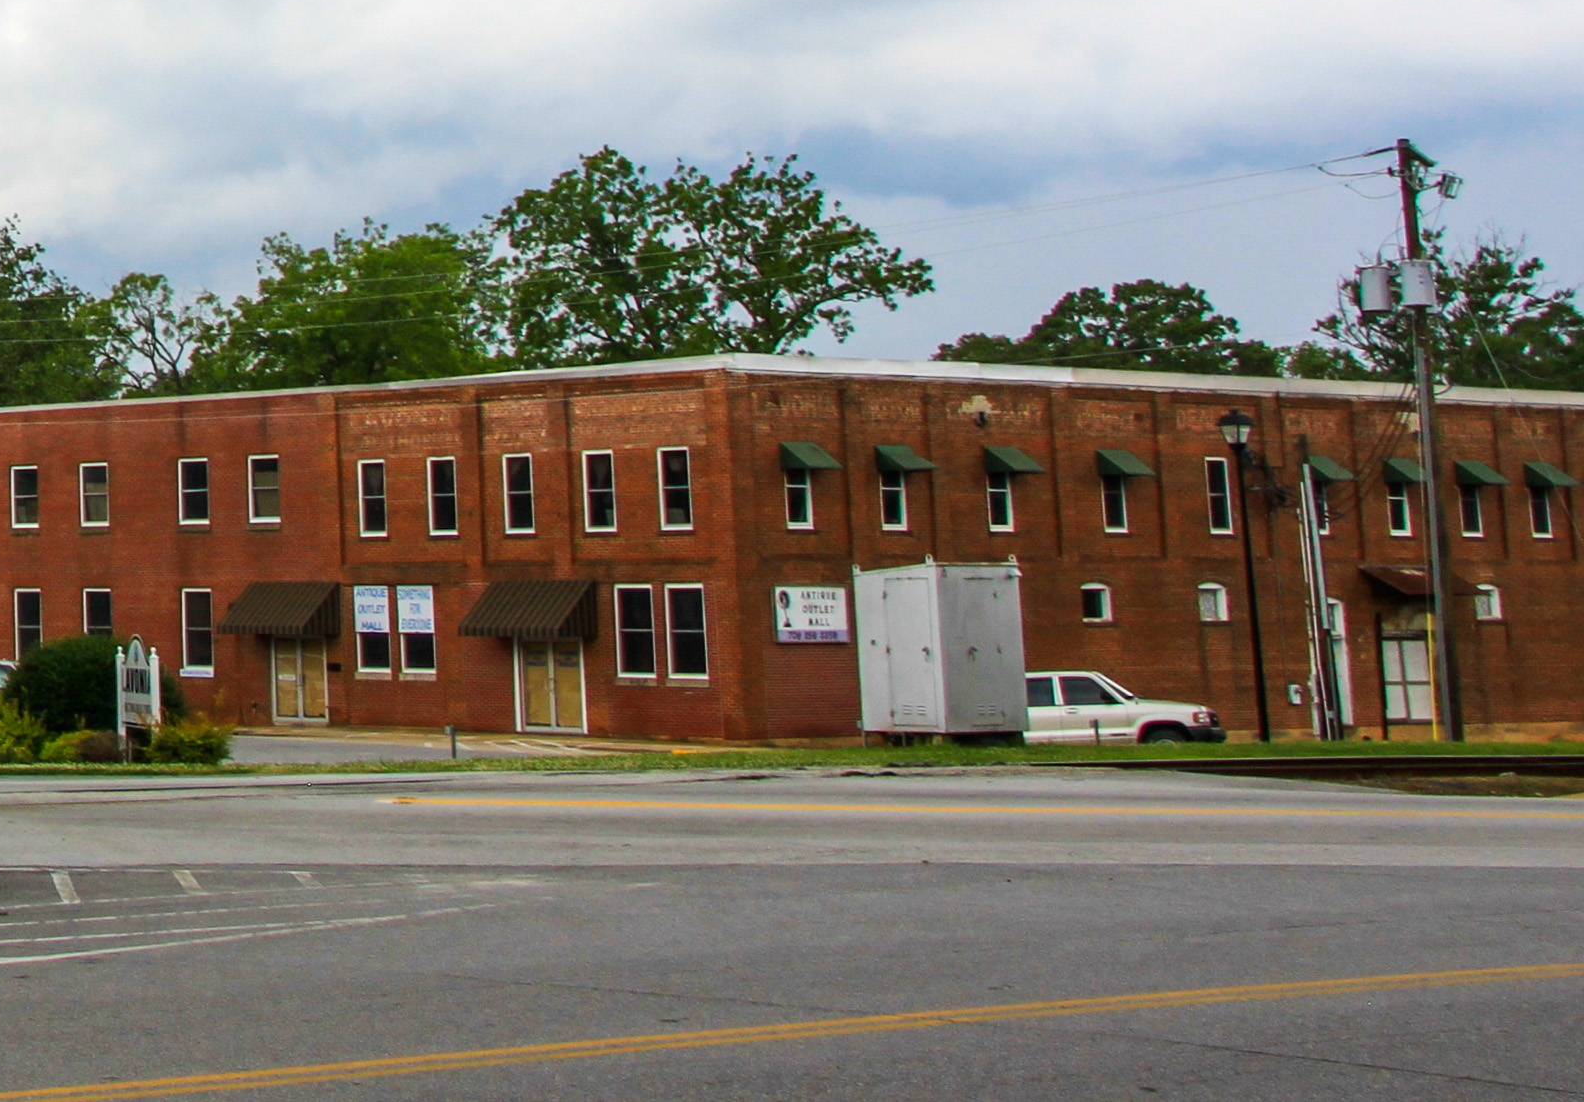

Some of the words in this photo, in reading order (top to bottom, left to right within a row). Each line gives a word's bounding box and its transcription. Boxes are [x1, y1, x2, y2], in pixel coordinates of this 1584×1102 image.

[355, 587, 387, 598] ANTIQUE
[801, 591, 837, 600] ANTIQUE
[358, 604, 386, 614] OUTLET
[802, 605, 835, 614] OUTLET
[361, 621, 384, 631] MALL
[808, 618, 830, 627] MALL
